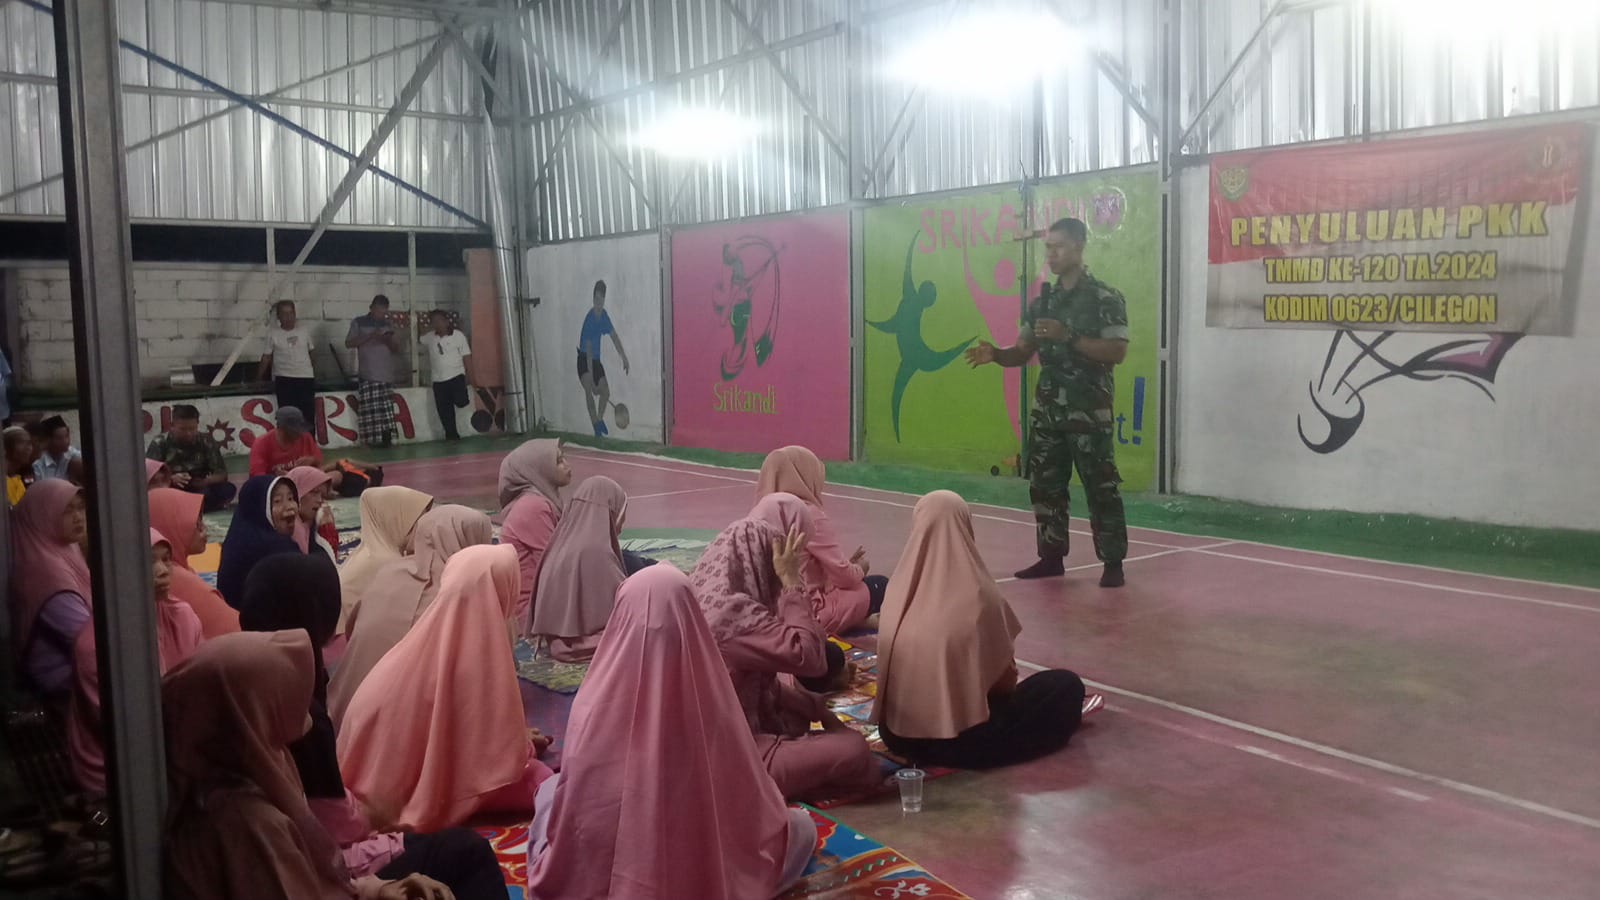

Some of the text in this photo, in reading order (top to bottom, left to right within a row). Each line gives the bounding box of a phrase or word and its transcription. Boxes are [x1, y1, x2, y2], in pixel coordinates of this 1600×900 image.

[1231, 201, 1549, 246] PENYULUAN PKK
[1264, 251, 1498, 283] TMMD KE-120 TA.2024
[1264, 294, 1497, 322] KODIM 0623/CILEGON
[713, 383, 778, 414] Srikandi
